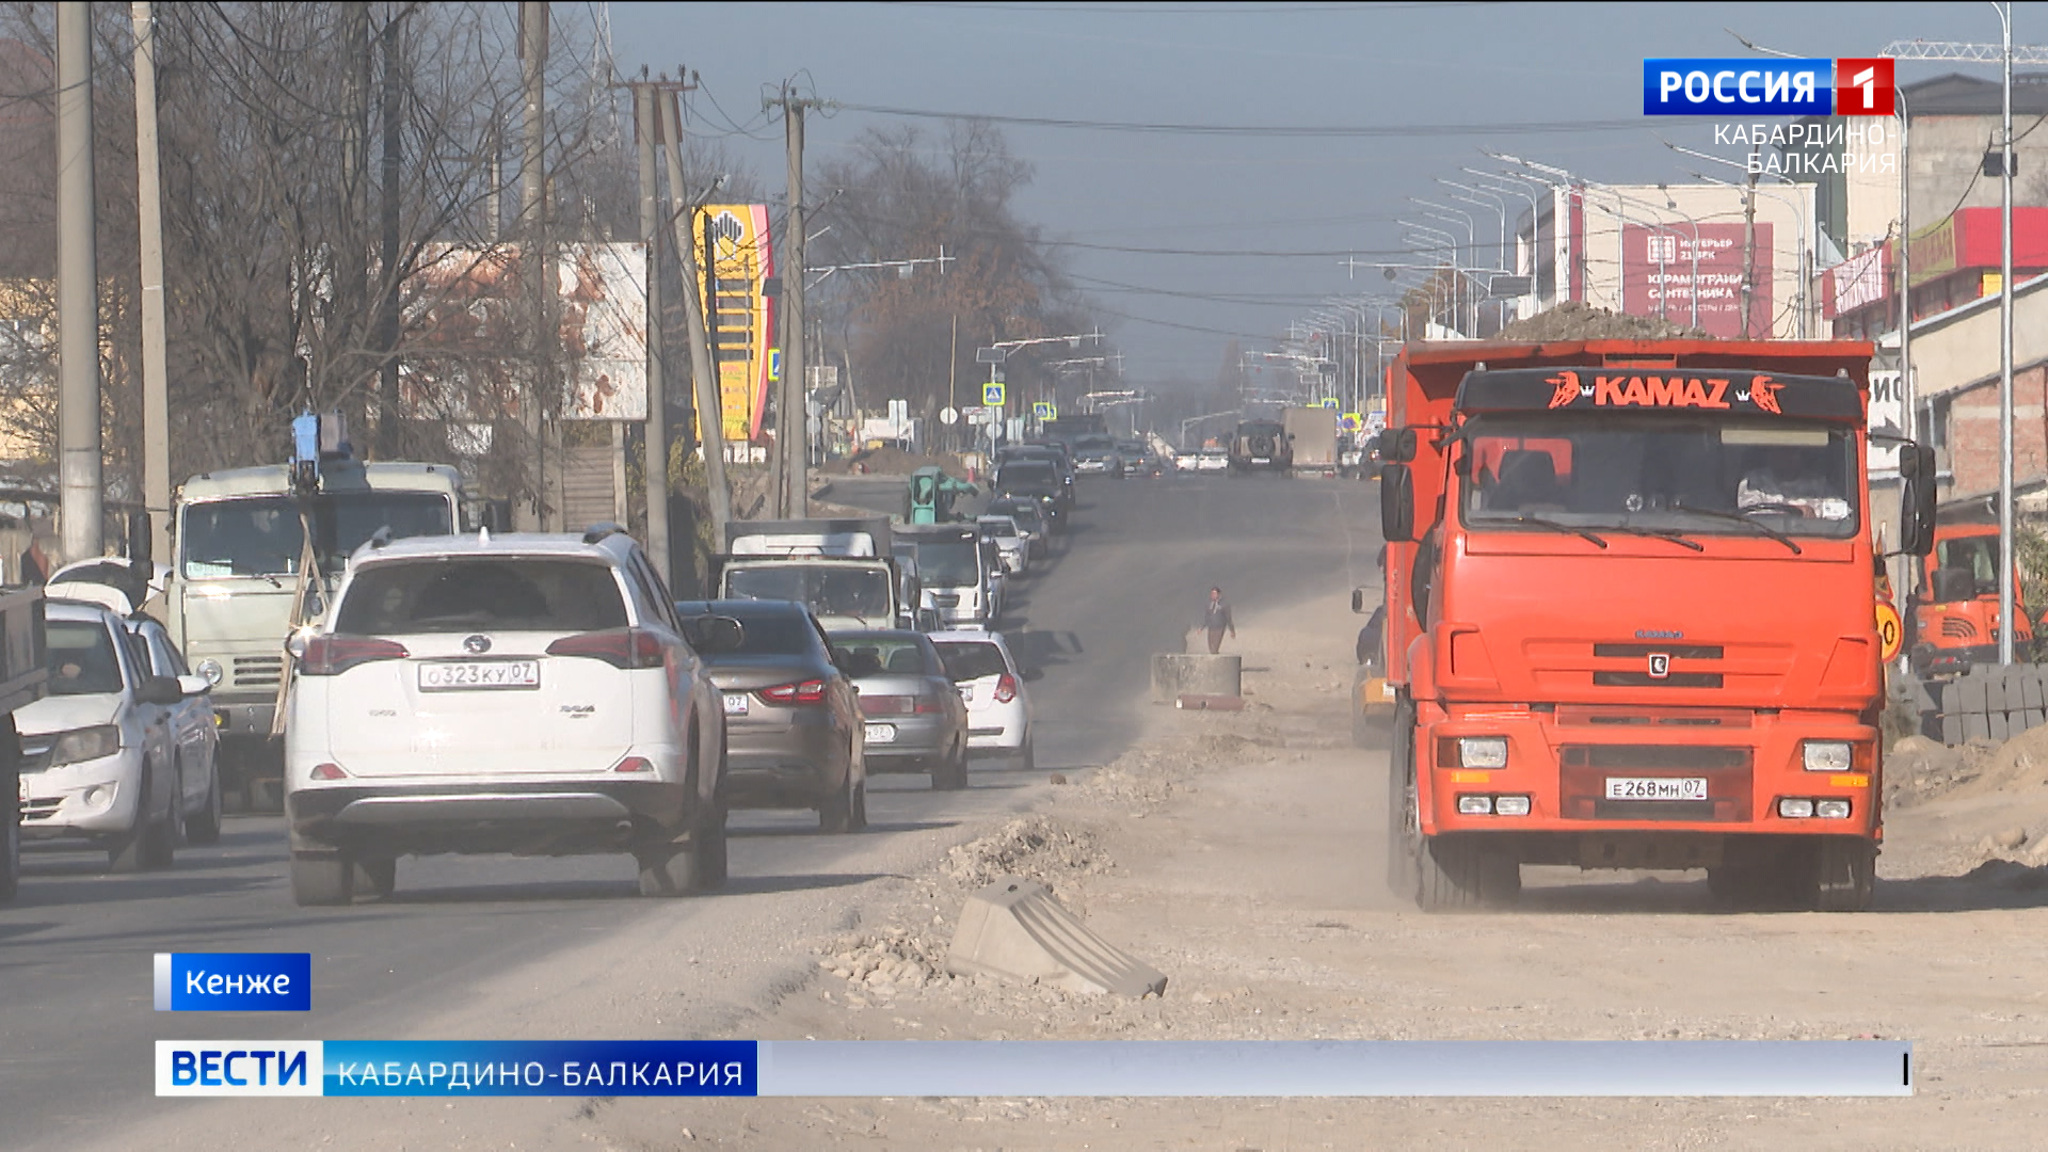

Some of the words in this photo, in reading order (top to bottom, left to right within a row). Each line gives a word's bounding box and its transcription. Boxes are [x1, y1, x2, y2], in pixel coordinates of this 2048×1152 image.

[1595, 376, 1731, 409] KAMAZ
[428, 665, 506, 684] О323КУ
[512, 663, 532, 679] 07
[1613, 781, 1680, 797] Е268МН
[1685, 780, 1701, 794] 07
